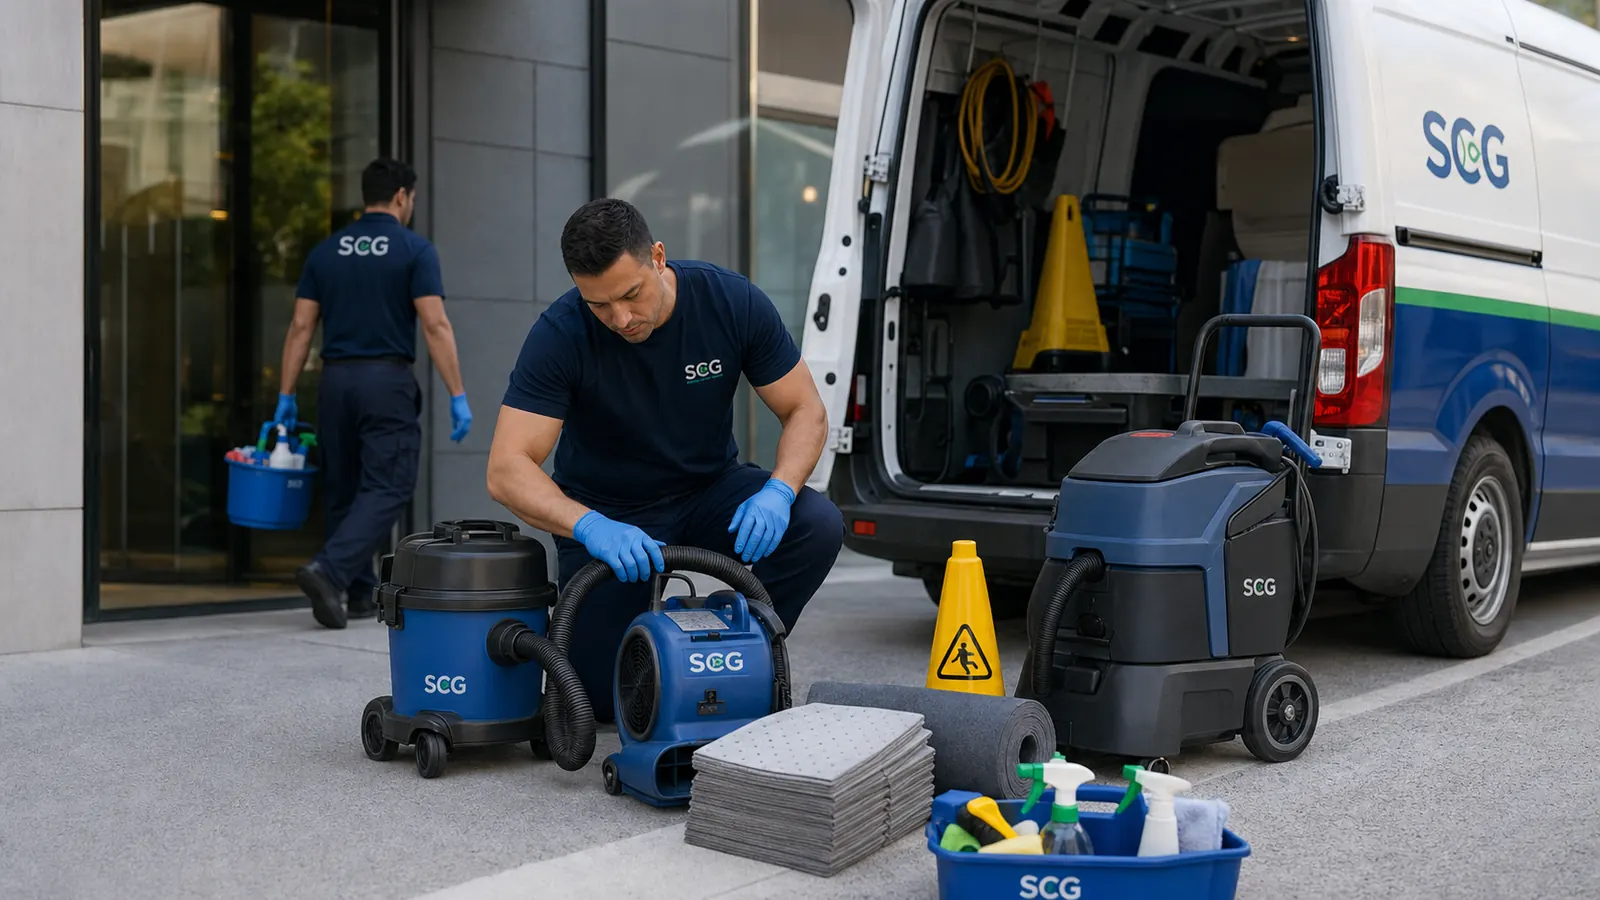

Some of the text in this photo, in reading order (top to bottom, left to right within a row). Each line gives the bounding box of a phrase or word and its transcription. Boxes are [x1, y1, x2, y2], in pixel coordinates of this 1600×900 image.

[1422, 110, 1510, 189] SCG
[338, 235, 389, 256] SCG
[684, 359, 722, 380] SCG
[1243, 577, 1276, 596] SCG
[689, 651, 744, 673] SCG
[424, 674, 467, 695] SCG
[1019, 875, 1081, 900] SCG
